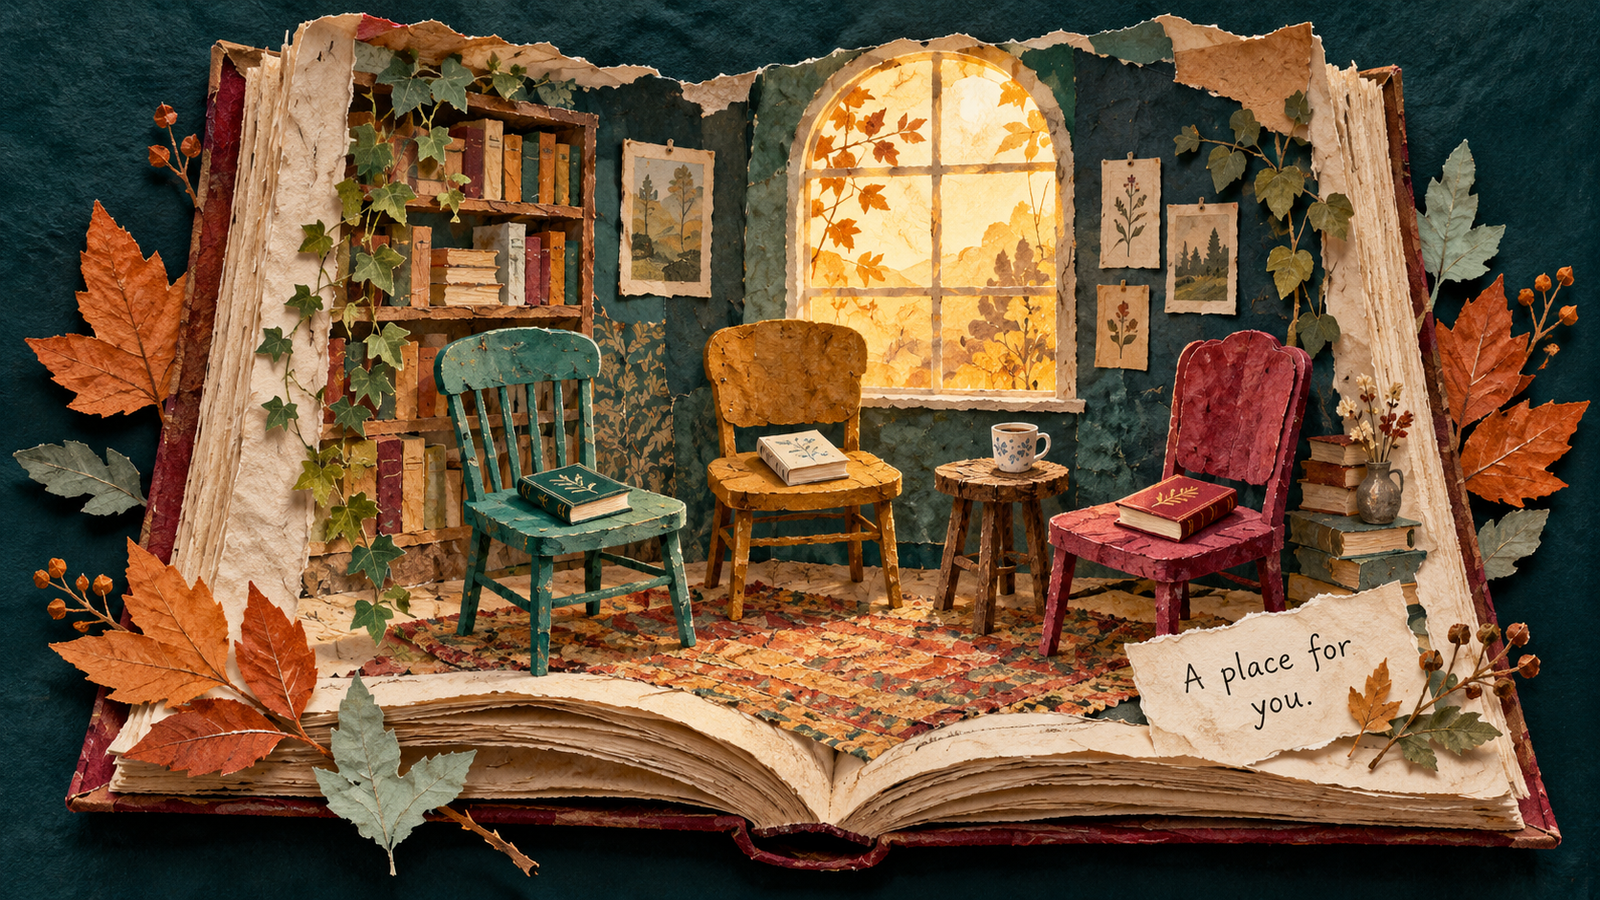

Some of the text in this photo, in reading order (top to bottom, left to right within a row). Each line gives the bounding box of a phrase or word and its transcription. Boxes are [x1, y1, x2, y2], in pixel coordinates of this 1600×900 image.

[1184, 633, 1351, 696] A place for
[1251, 692, 1312, 731] you.
